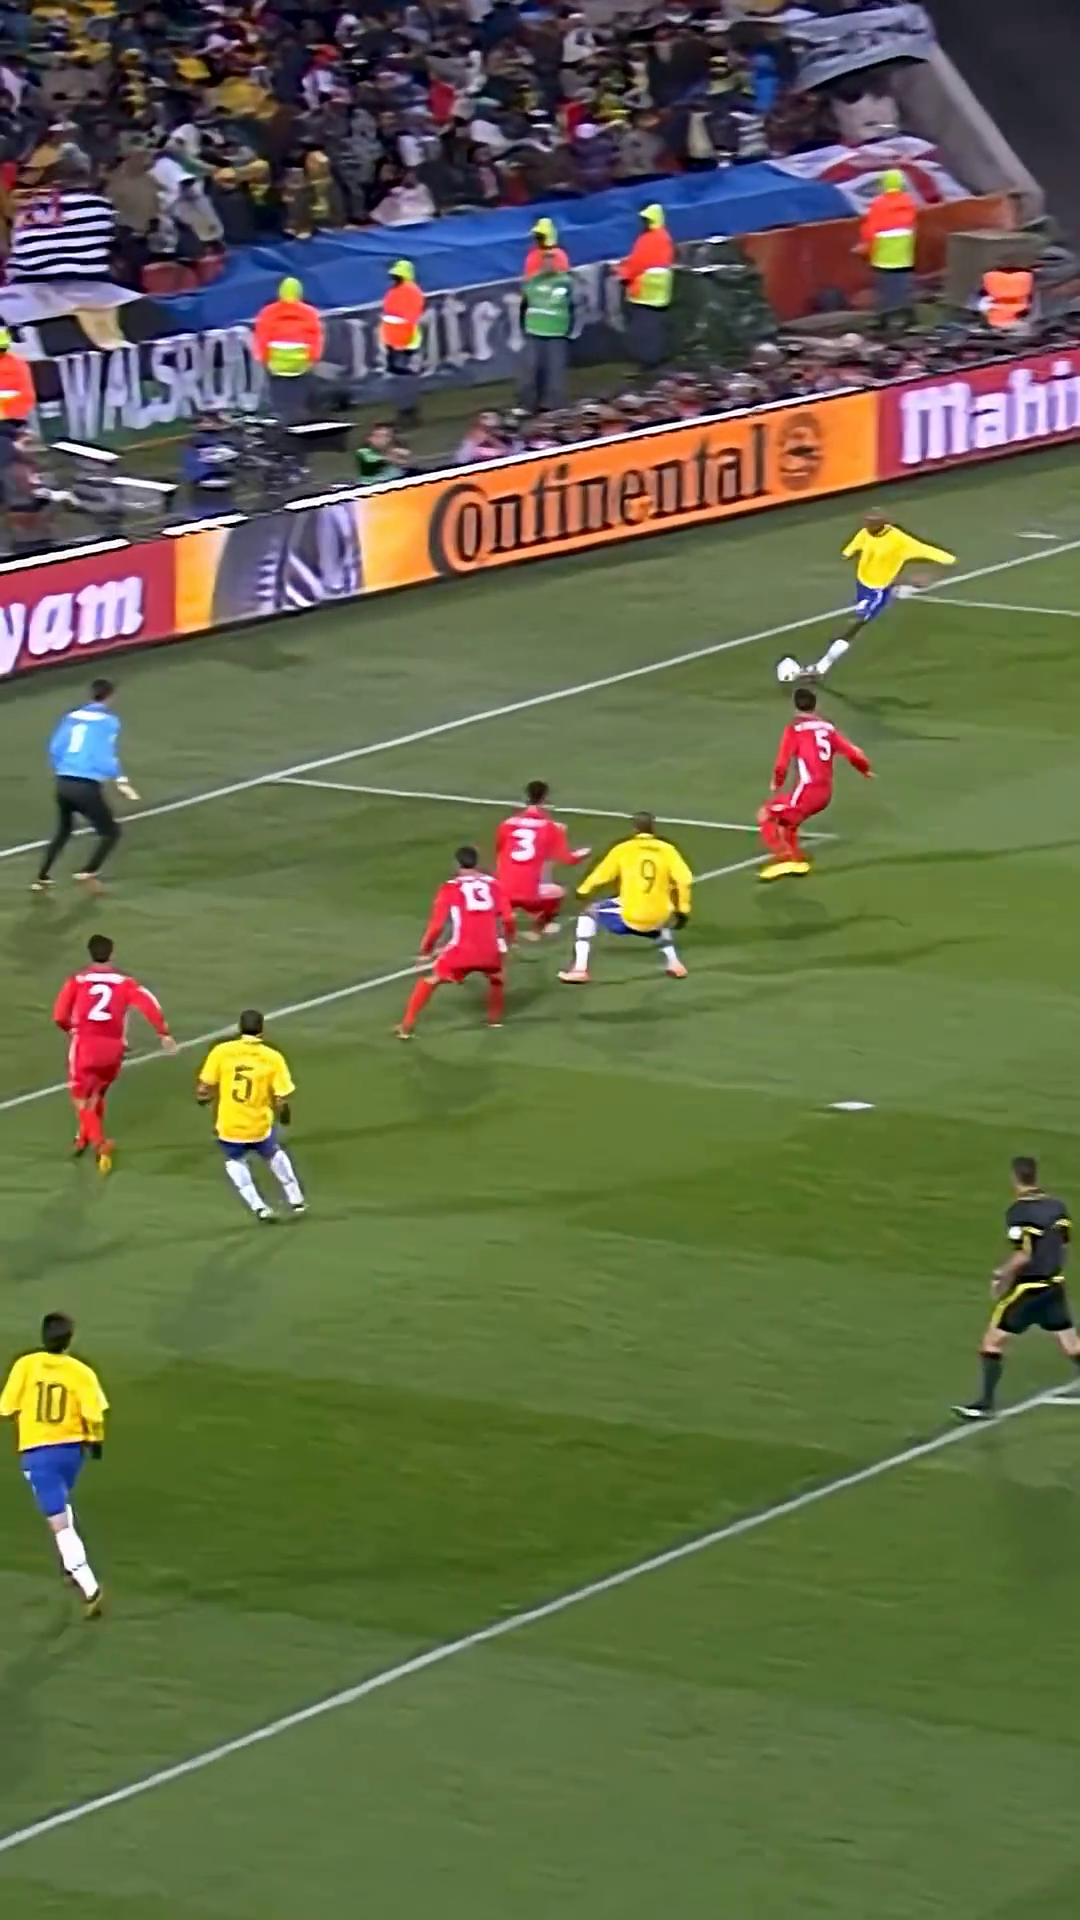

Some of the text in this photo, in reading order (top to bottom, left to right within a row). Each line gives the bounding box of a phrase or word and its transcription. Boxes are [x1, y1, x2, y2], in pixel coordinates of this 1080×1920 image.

[428, 423, 772, 577] Continental
[814, 729, 832, 761] 5
[510, 828, 537, 862] 3
[459, 880, 495, 911] 13
[641, 859, 656, 895] 9
[87, 983, 113, 1021] 2
[232, 1064, 254, 1103] 5
[35, 1380, 68, 1424] 10
